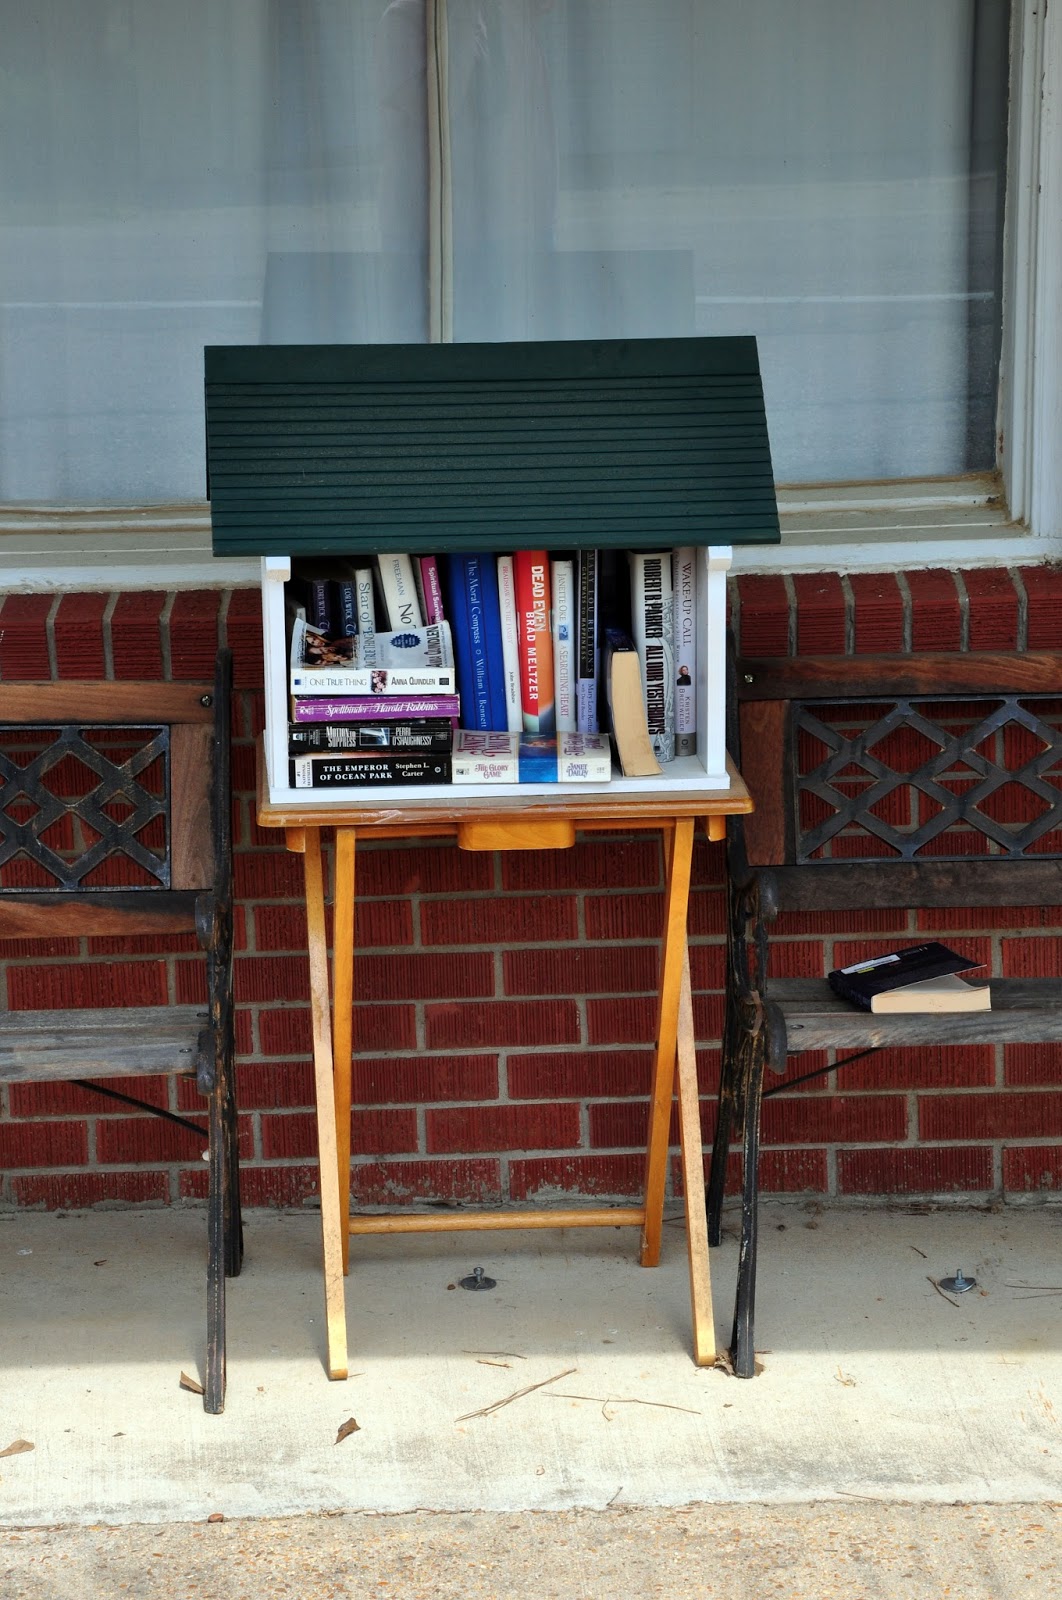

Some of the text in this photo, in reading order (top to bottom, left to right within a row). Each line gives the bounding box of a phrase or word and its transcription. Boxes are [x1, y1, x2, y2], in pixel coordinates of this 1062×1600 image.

[393, 560, 405, 596] FREEMAN
[429, 567, 438, 596] Spiritual
[644, 559, 662, 592] ROBERT
[359, 583, 370, 609] Star
[432, 596, 441, 623] Survival
[468, 560, 481, 644] The Moral Compass
[531, 566, 546, 632] DEAD EVEN
[557, 574, 567, 620] JANETTE OKE
[682, 563, 692, 646] WAKE-UP CALL
[361, 612, 373, 626] of
[645, 603, 663, 638] PARKER
[526, 612, 538, 700] BRAD MELTZER
[310, 678, 325, 686] ONE
[326, 678, 343, 686] TRUE
[345, 678, 367, 686] THING
[391, 677, 408, 685] ANNA
[409, 677, 435, 685] QUINDLEN
[476, 658, 485, 689] William
[560, 650, 569, 692] SEARCHING
[646, 645, 665, 735] ALL OUR YESTERDAYS
[325, 704, 367, 717] Spellbinder
[373, 702, 403, 713] Harold
[405, 701, 438, 712] Robbins
[561, 694, 569, 716] HEART
[326, 726, 349, 738] MOTION
[328, 737, 356, 747] SUPPRESS
[396, 727, 411, 736] PERRI
[484, 771, 502, 779] GAME
[489, 764, 509, 772] GLORY
[566, 769, 588, 778] DAILEY
